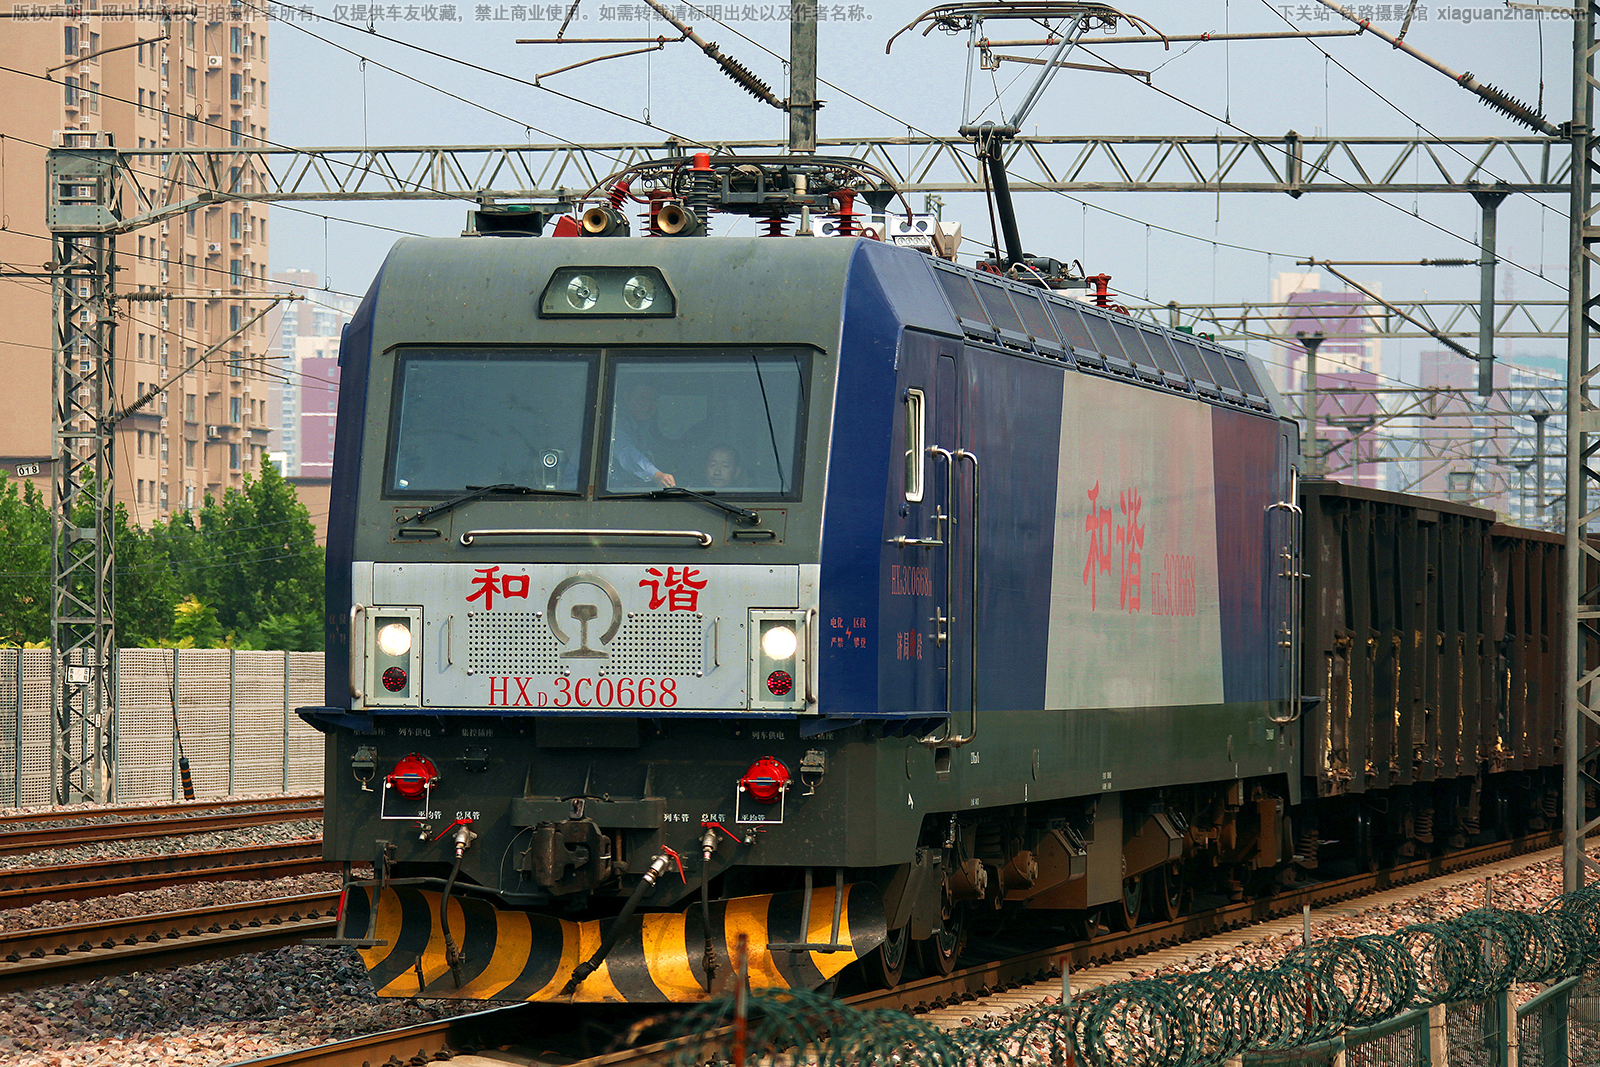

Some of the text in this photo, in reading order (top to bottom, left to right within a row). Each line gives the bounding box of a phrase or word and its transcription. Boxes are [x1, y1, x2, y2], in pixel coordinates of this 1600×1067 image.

[18, 464, 38, 476] 018
[1083, 480, 1145, 614] 和谐
[465, 565, 708, 612] 和 谐
[830, 617, 867, 628] 电化 区段
[488, 676, 678, 707] HXD3C0668
[398, 728, 432, 737] 列车供电
[751, 731, 785, 740] 列车供电
[455, 811, 481, 820] 总风管
[663, 813, 690, 822] 列车管
[701, 813, 726, 822] 总风管
